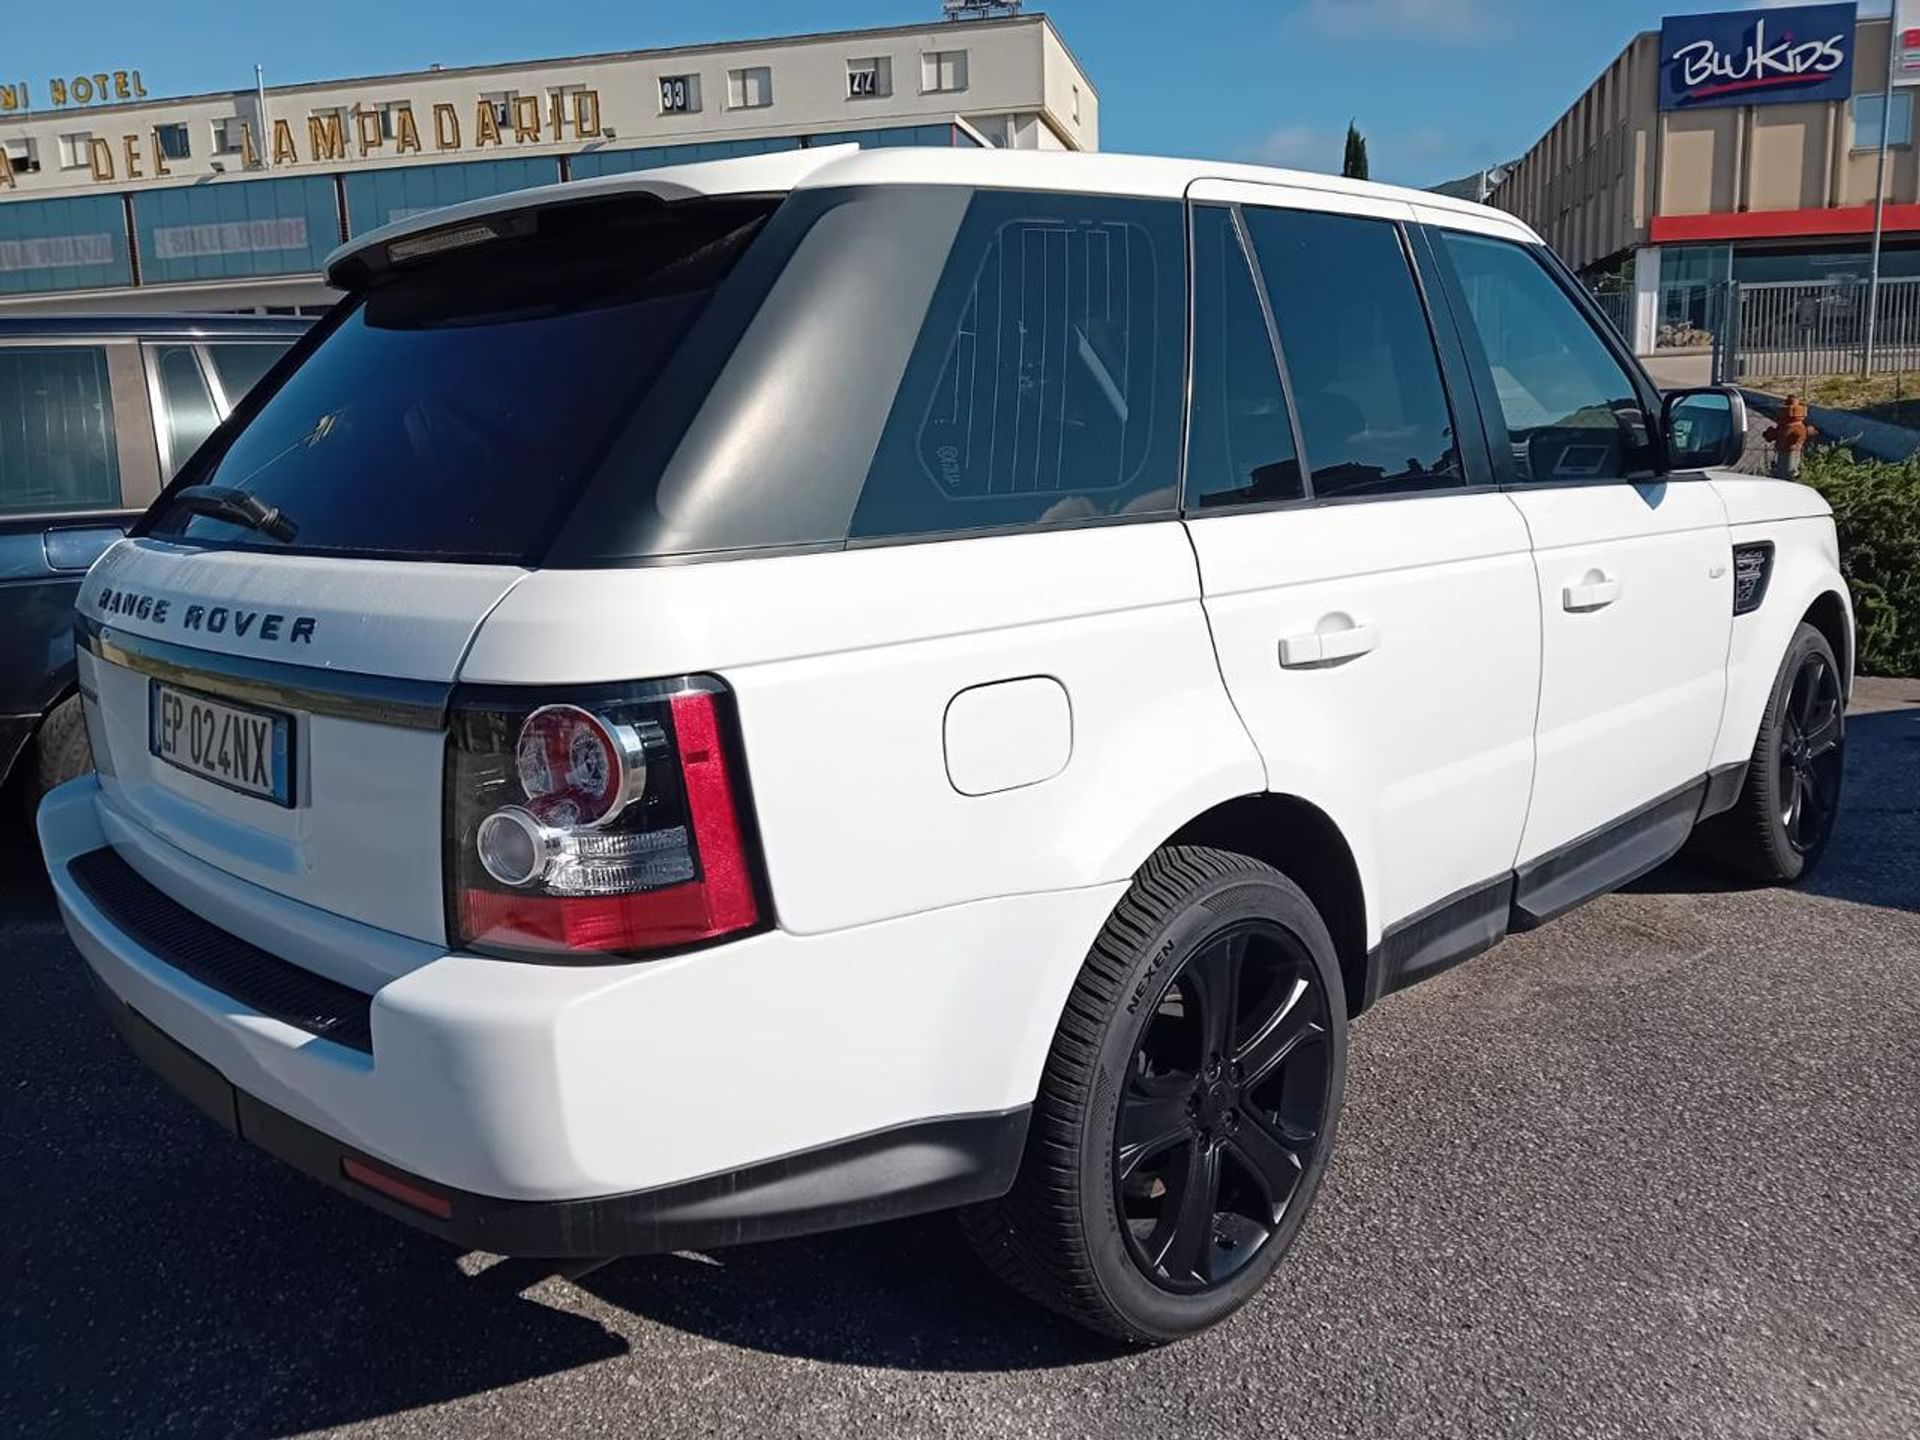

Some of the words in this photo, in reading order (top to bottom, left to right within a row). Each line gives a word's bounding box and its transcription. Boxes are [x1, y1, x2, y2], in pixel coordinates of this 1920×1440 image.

[49, 70, 148, 106] HOTEL
[663, 81, 685, 108] 33
[87, 131, 172, 181] DEL
[240, 90, 602, 171] LAMPADARIO
[98, 588, 171, 624] RANGE
[183, 604, 317, 644] ROVER
[162, 691, 184, 755] EP
[190, 704, 270, 788] 024NX
[1126, 938, 1175, 1015] NEXEN
